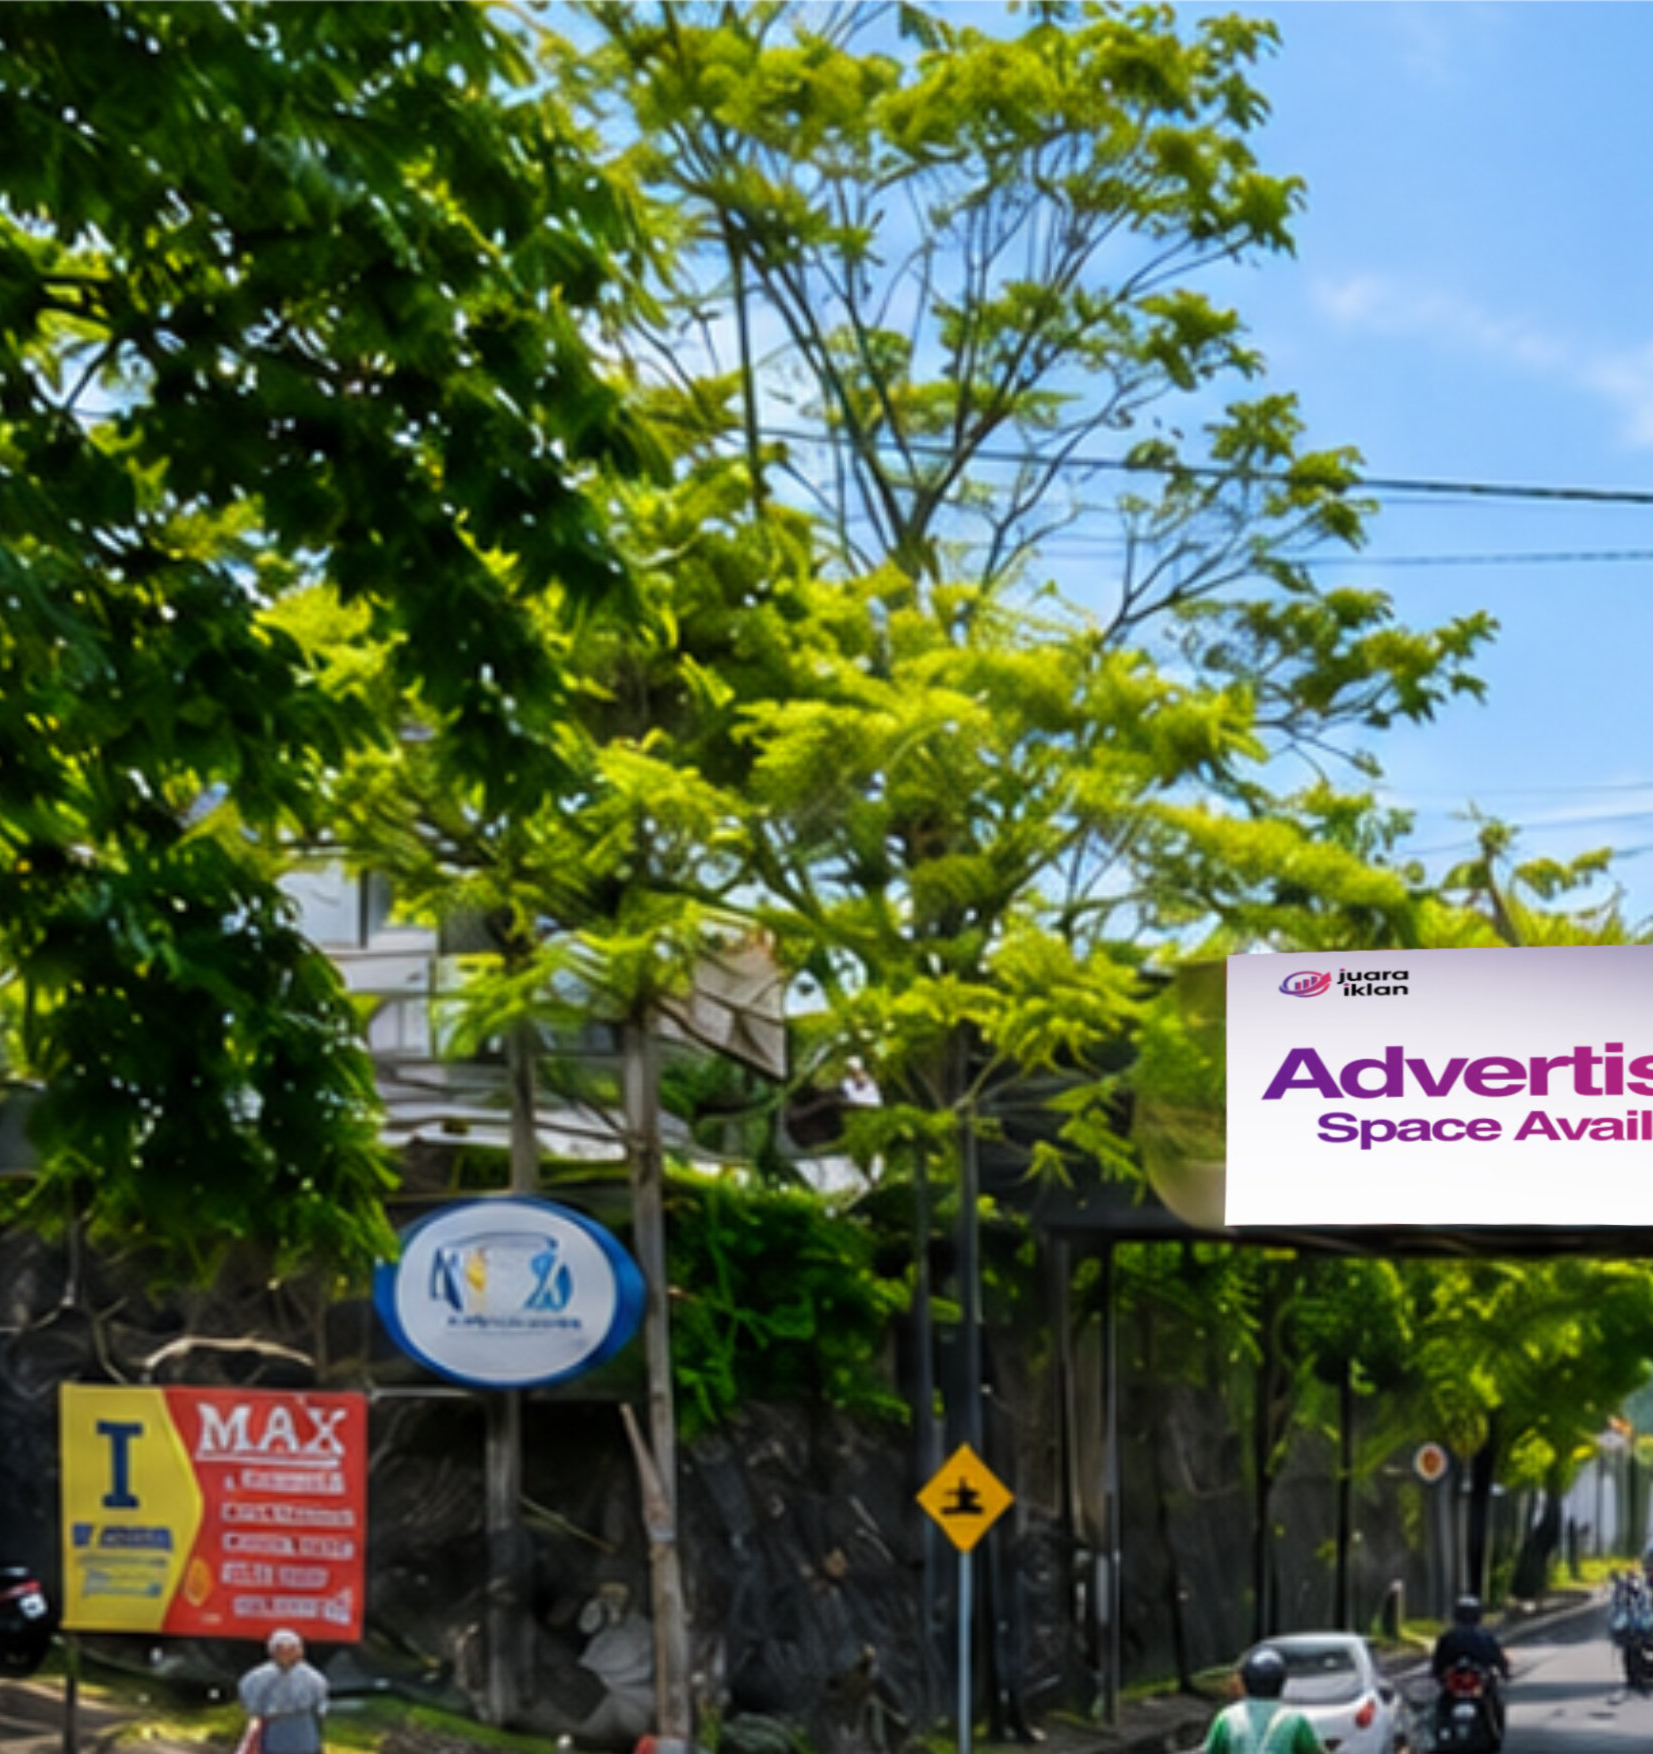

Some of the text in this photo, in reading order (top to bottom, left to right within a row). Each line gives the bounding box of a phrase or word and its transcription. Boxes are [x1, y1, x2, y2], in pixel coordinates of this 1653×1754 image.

[1337, 968, 1409, 985] juara
[1343, 983, 1409, 997] iklan
[1317, 1112, 1503, 1150] Space
[197, 1402, 348, 1455] MAX
